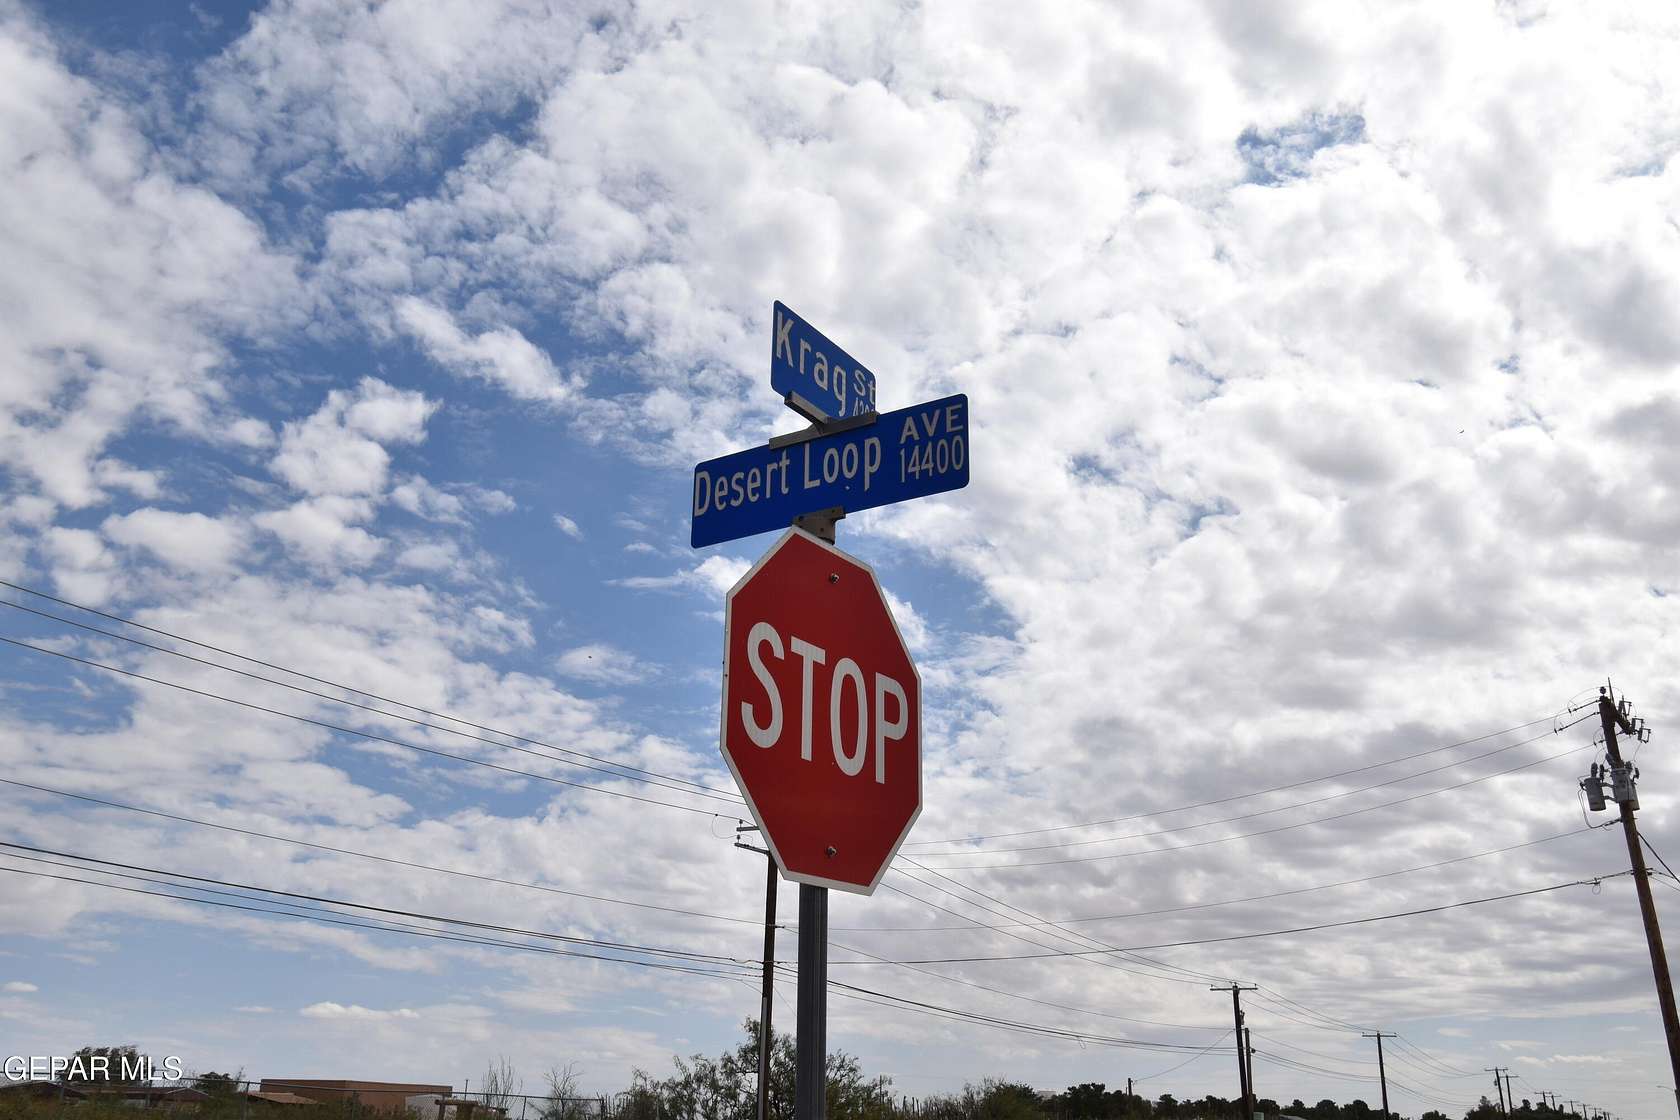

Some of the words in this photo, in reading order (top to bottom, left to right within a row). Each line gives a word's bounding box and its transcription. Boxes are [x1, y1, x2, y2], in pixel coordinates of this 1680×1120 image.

[776, 310, 846, 417] Krag
[854, 369, 876, 405] St
[694, 449, 790, 517] Desert
[804, 436, 881, 491] Loop
[900, 403, 964, 445] AVE
[900, 435, 964, 483] 14400
[741, 621, 909, 784] STOP
